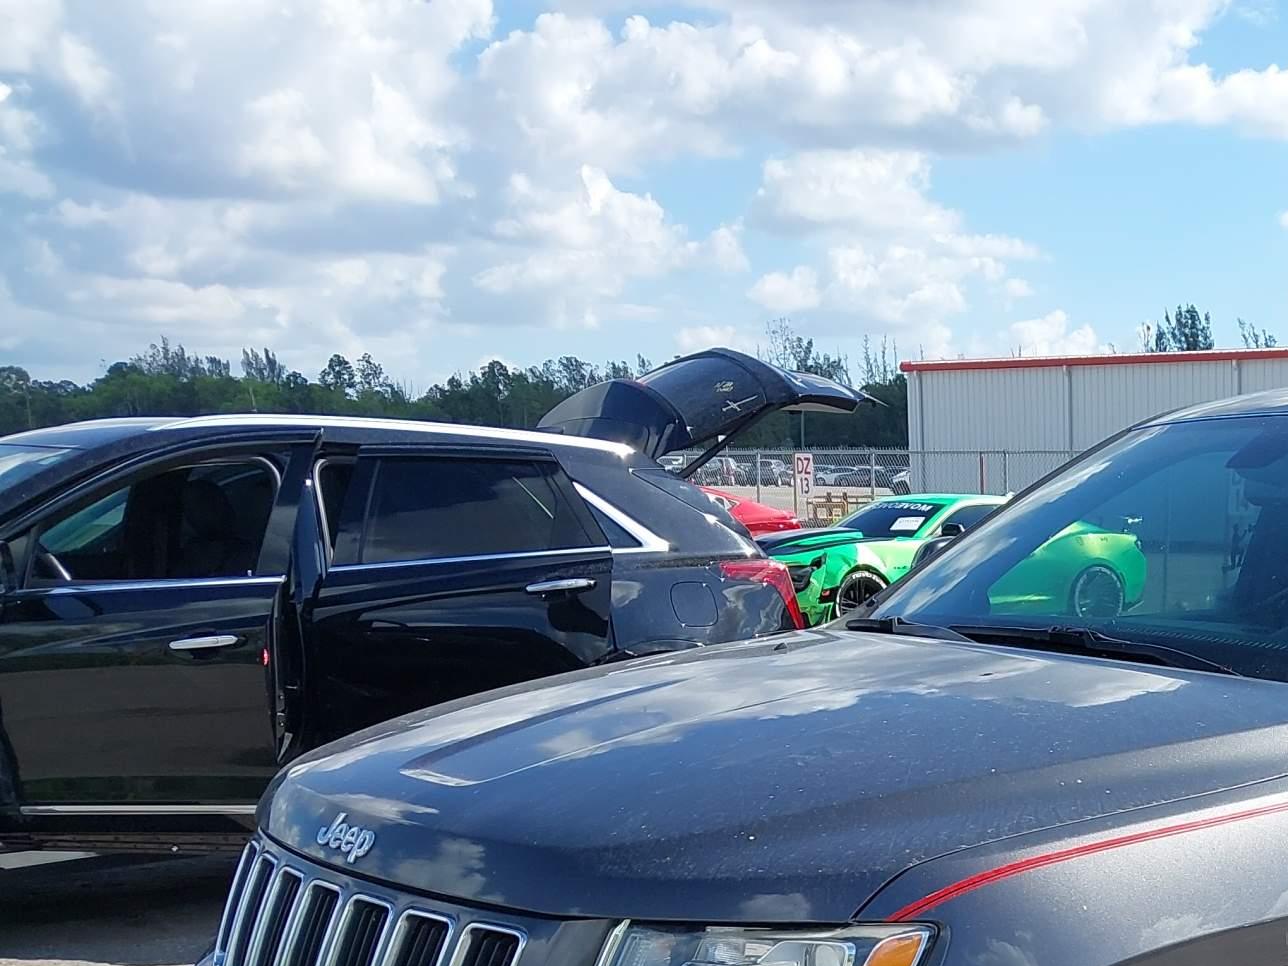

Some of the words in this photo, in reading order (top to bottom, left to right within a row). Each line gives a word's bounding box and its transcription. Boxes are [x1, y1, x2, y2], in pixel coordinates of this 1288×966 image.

[796, 456, 811, 475] DZ
[799, 477, 810, 494] 13
[317, 812, 376, 864] Jeep
